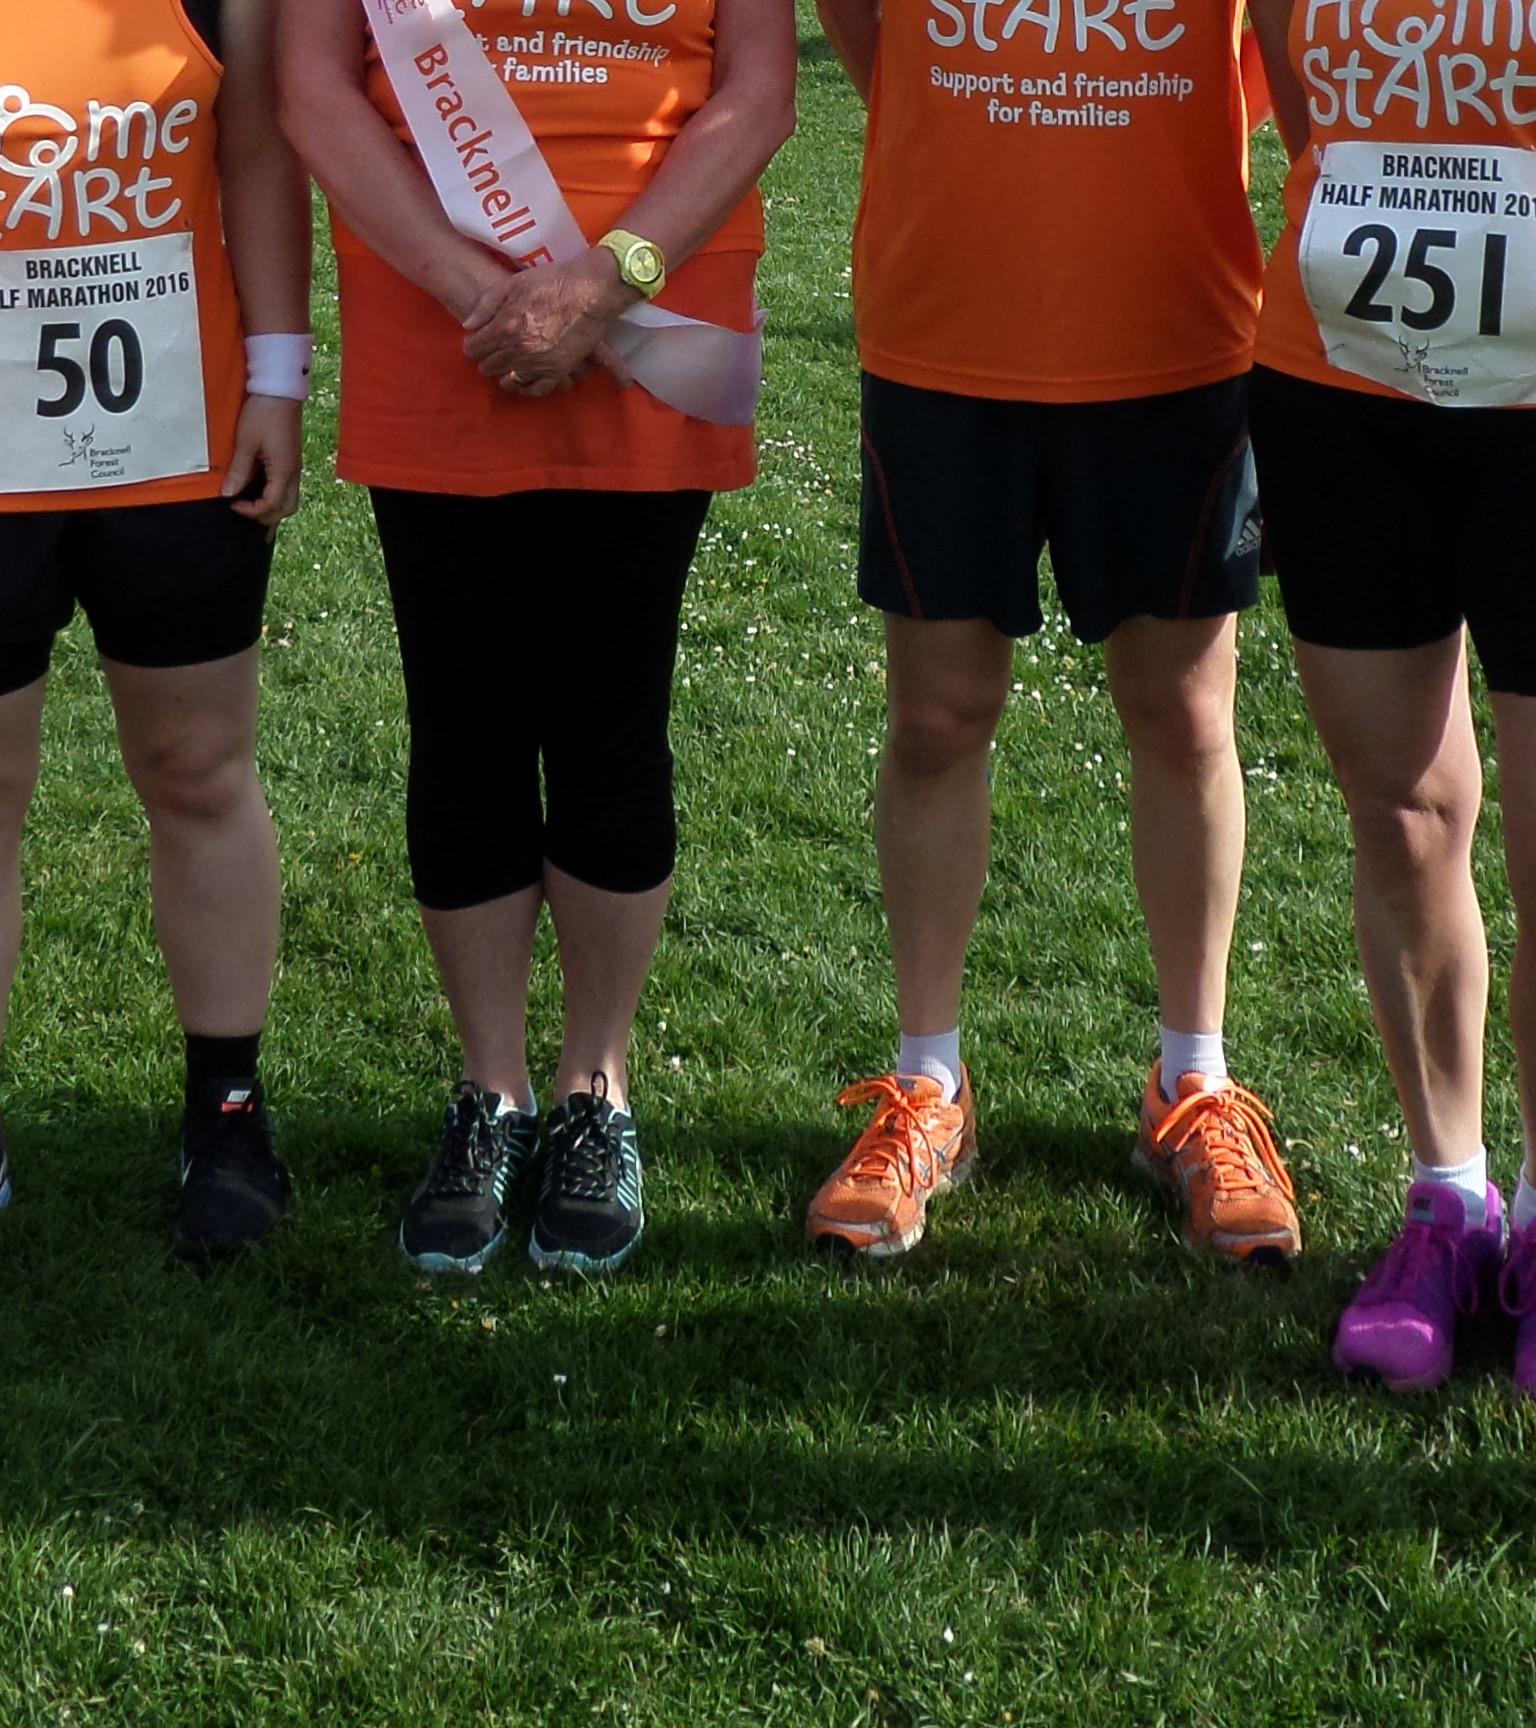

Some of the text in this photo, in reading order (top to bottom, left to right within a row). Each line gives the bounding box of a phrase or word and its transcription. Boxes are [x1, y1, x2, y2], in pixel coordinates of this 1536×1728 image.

[497, 31, 544, 53] and
[553, 32, 669, 67] friendship
[504, 57, 608, 84] families
[930, 66, 1194, 102] Support and friendship
[987, 99, 1131, 126] for families
[414, 43, 537, 242] Bracknell
[1381, 154, 1504, 182] BRACKNELL
[1320, 183, 1374, 207] HALF
[1378, 186, 1496, 214] MARATHON
[25, 251, 143, 280] BRACKNELL
[1342, 223, 1508, 336] 251
[27, 280, 140, 309] MARATHON
[145, 272, 190, 299] 2016
[36, 318, 144, 418] 50
